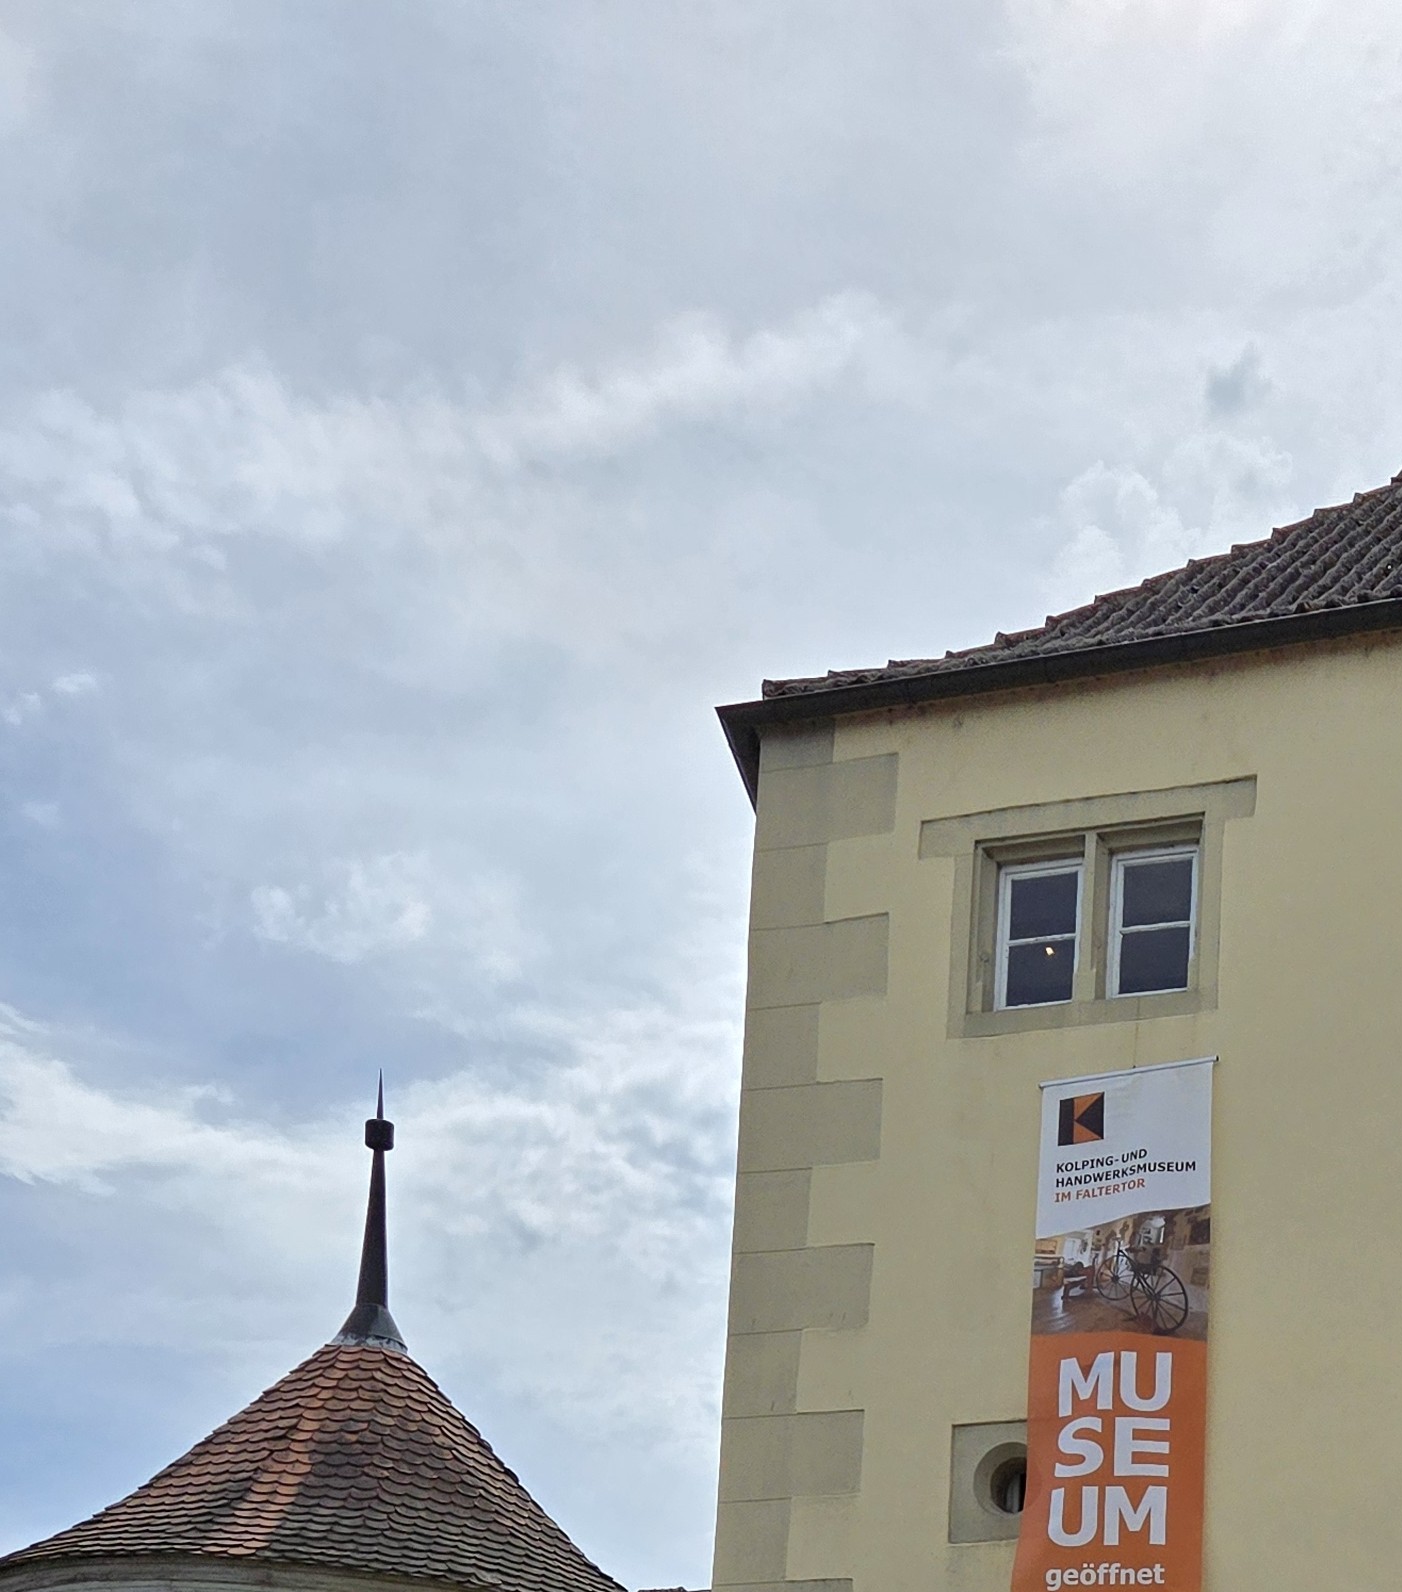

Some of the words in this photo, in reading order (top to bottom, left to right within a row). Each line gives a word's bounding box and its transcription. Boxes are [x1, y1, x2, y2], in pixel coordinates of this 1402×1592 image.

[1055, 1155, 1119, 1173] KOLPING-
[1121, 1148, 1148, 1163] UND
[1055, 1160, 1196, 1188] HANDWERKSMUSEUM
[1054, 1190, 1072, 1203] IM
[1075, 1178, 1146, 1200] FALTERTOR
[1058, 1351, 1173, 1417] MU
[1054, 1416, 1171, 1478] SE
[1047, 1485, 1168, 1547] UM
[1045, 1563, 1165, 1592] geöffnet
